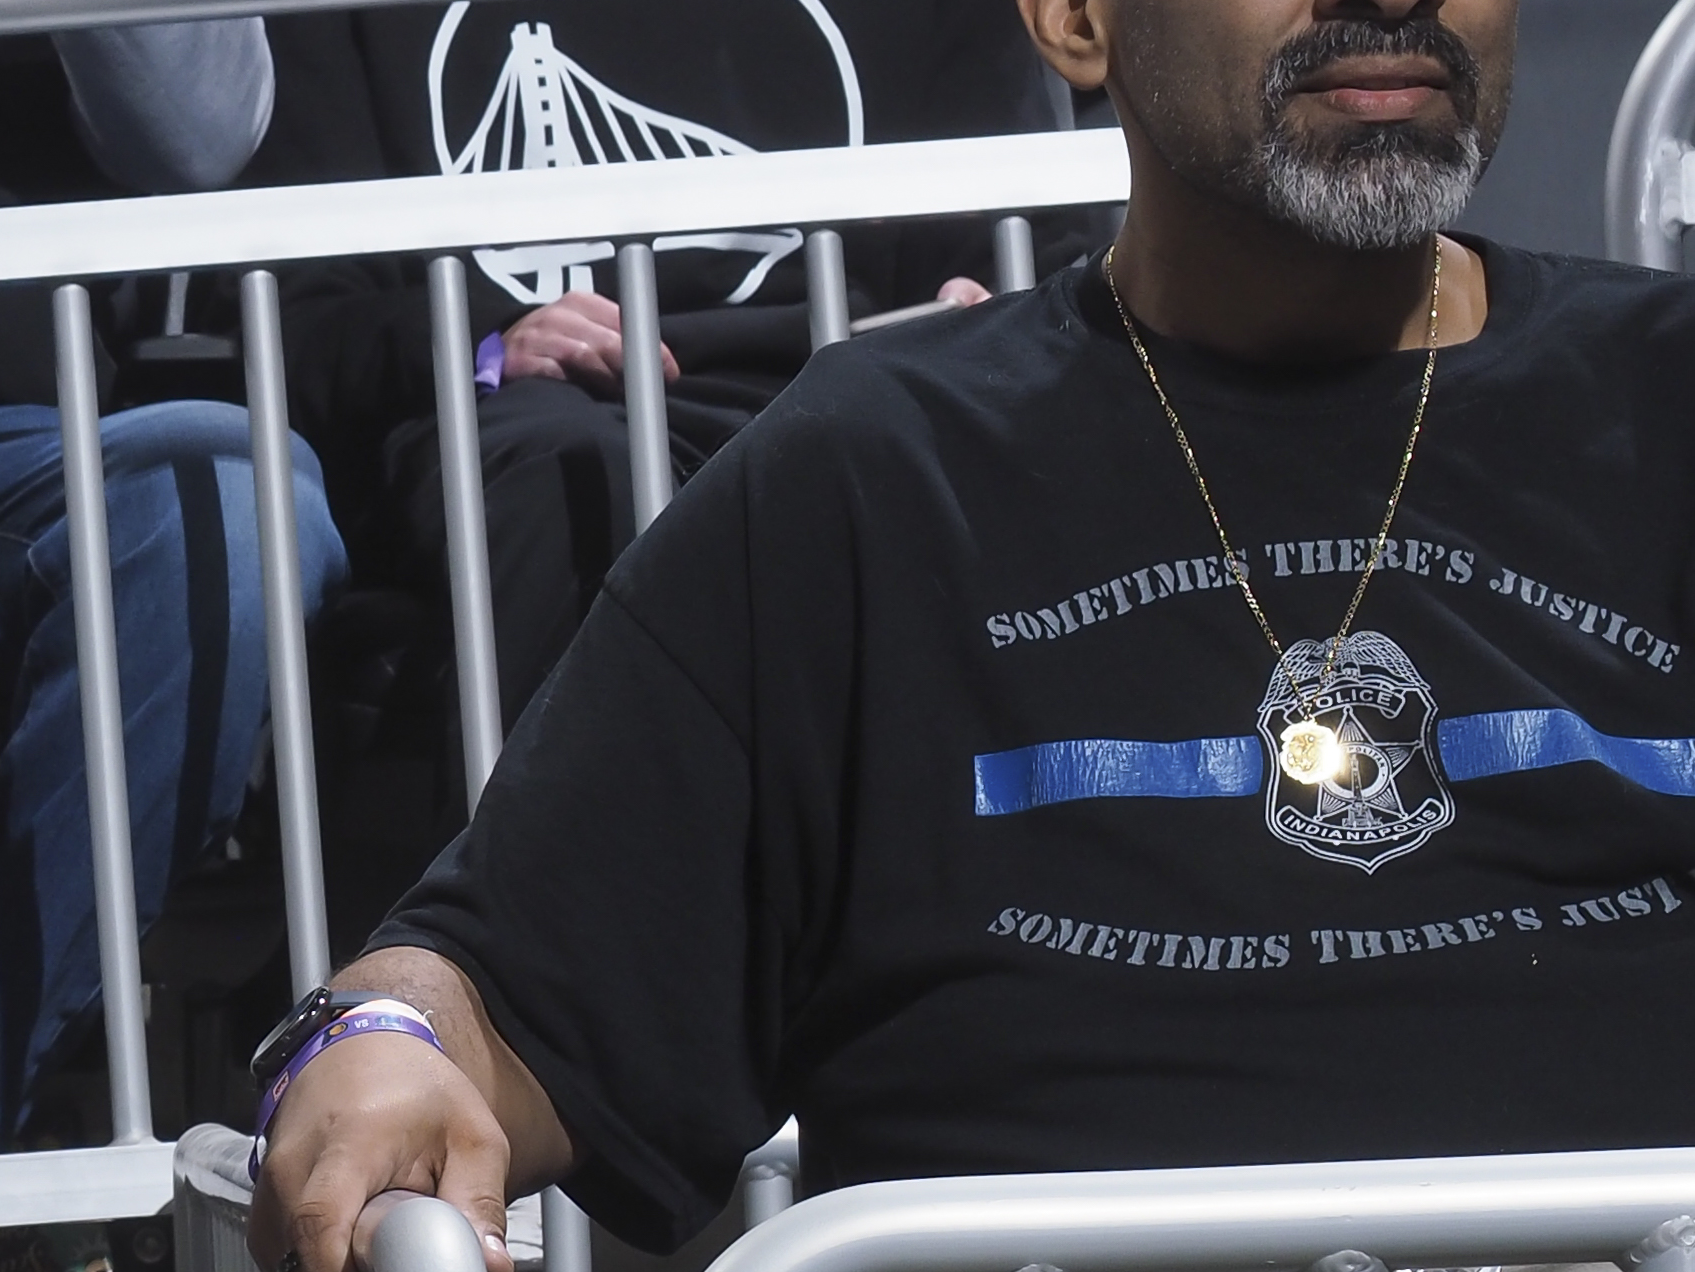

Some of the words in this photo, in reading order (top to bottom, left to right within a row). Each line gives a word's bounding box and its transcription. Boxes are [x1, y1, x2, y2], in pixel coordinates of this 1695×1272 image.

[986, 547, 1252, 650] SOMETIMES
[1263, 536, 1476, 586] THERE'S
[1488, 565, 1682, 675] JUSTICE
[1282, 808, 1439, 842] INDIANAPOLIS
[986, 906, 1292, 972] SOMETIMES
[1310, 907, 1544, 965] THERE'S
